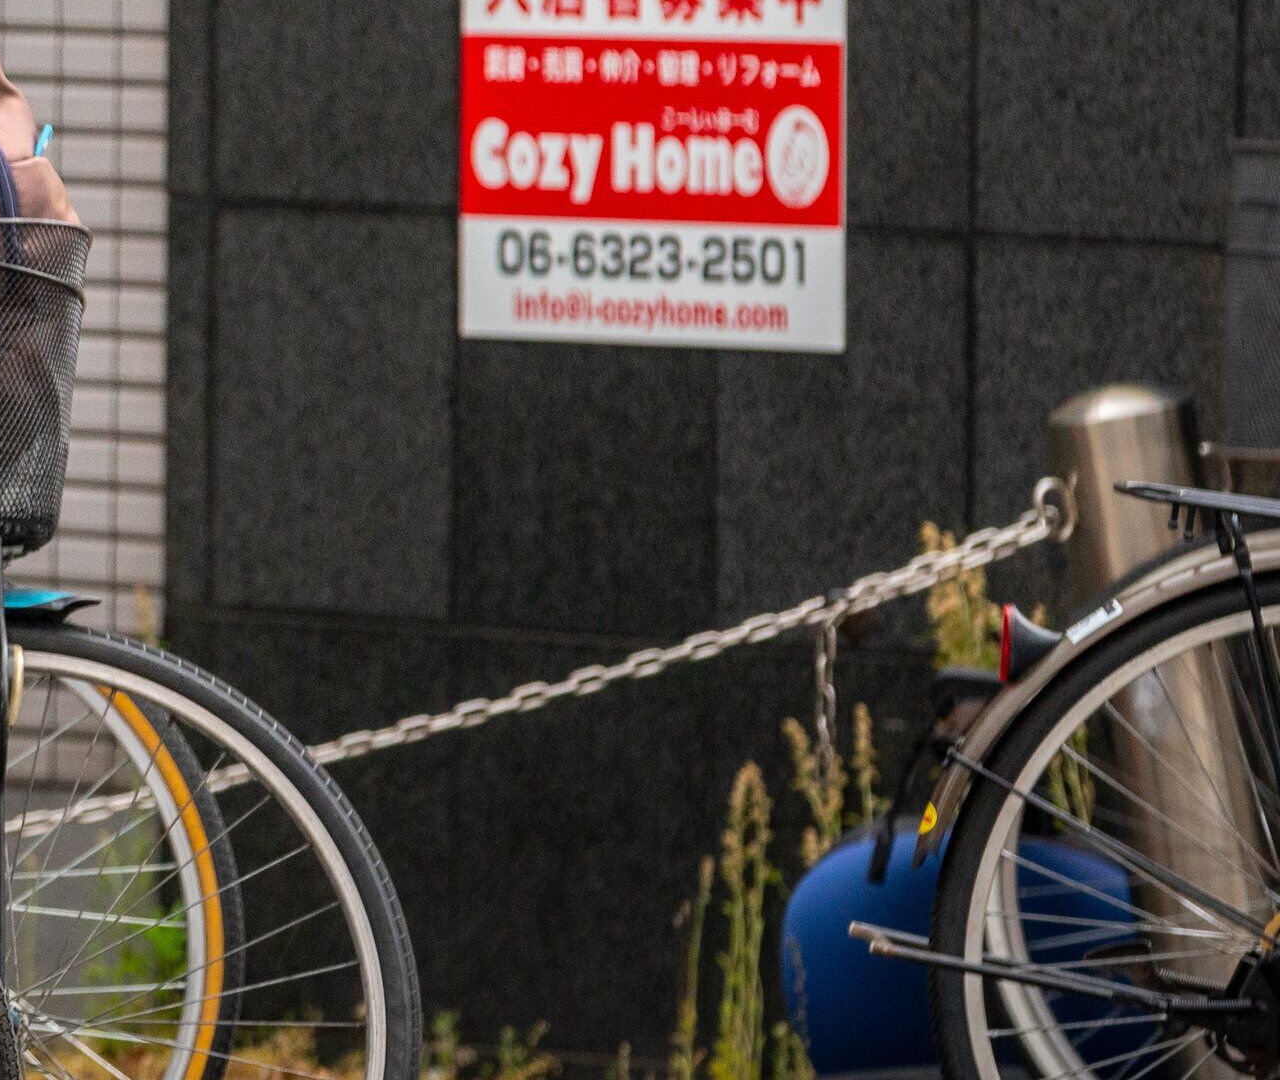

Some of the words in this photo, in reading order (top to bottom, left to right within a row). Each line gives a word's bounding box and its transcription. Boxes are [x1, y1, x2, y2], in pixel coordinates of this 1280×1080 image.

[470, 116, 604, 205] Cozy
[610, 120, 764, 198] Home
[497, 228, 806, 286] 06-6323-2501
[513, 288, 789, 331] info@i-cozyhome.com
